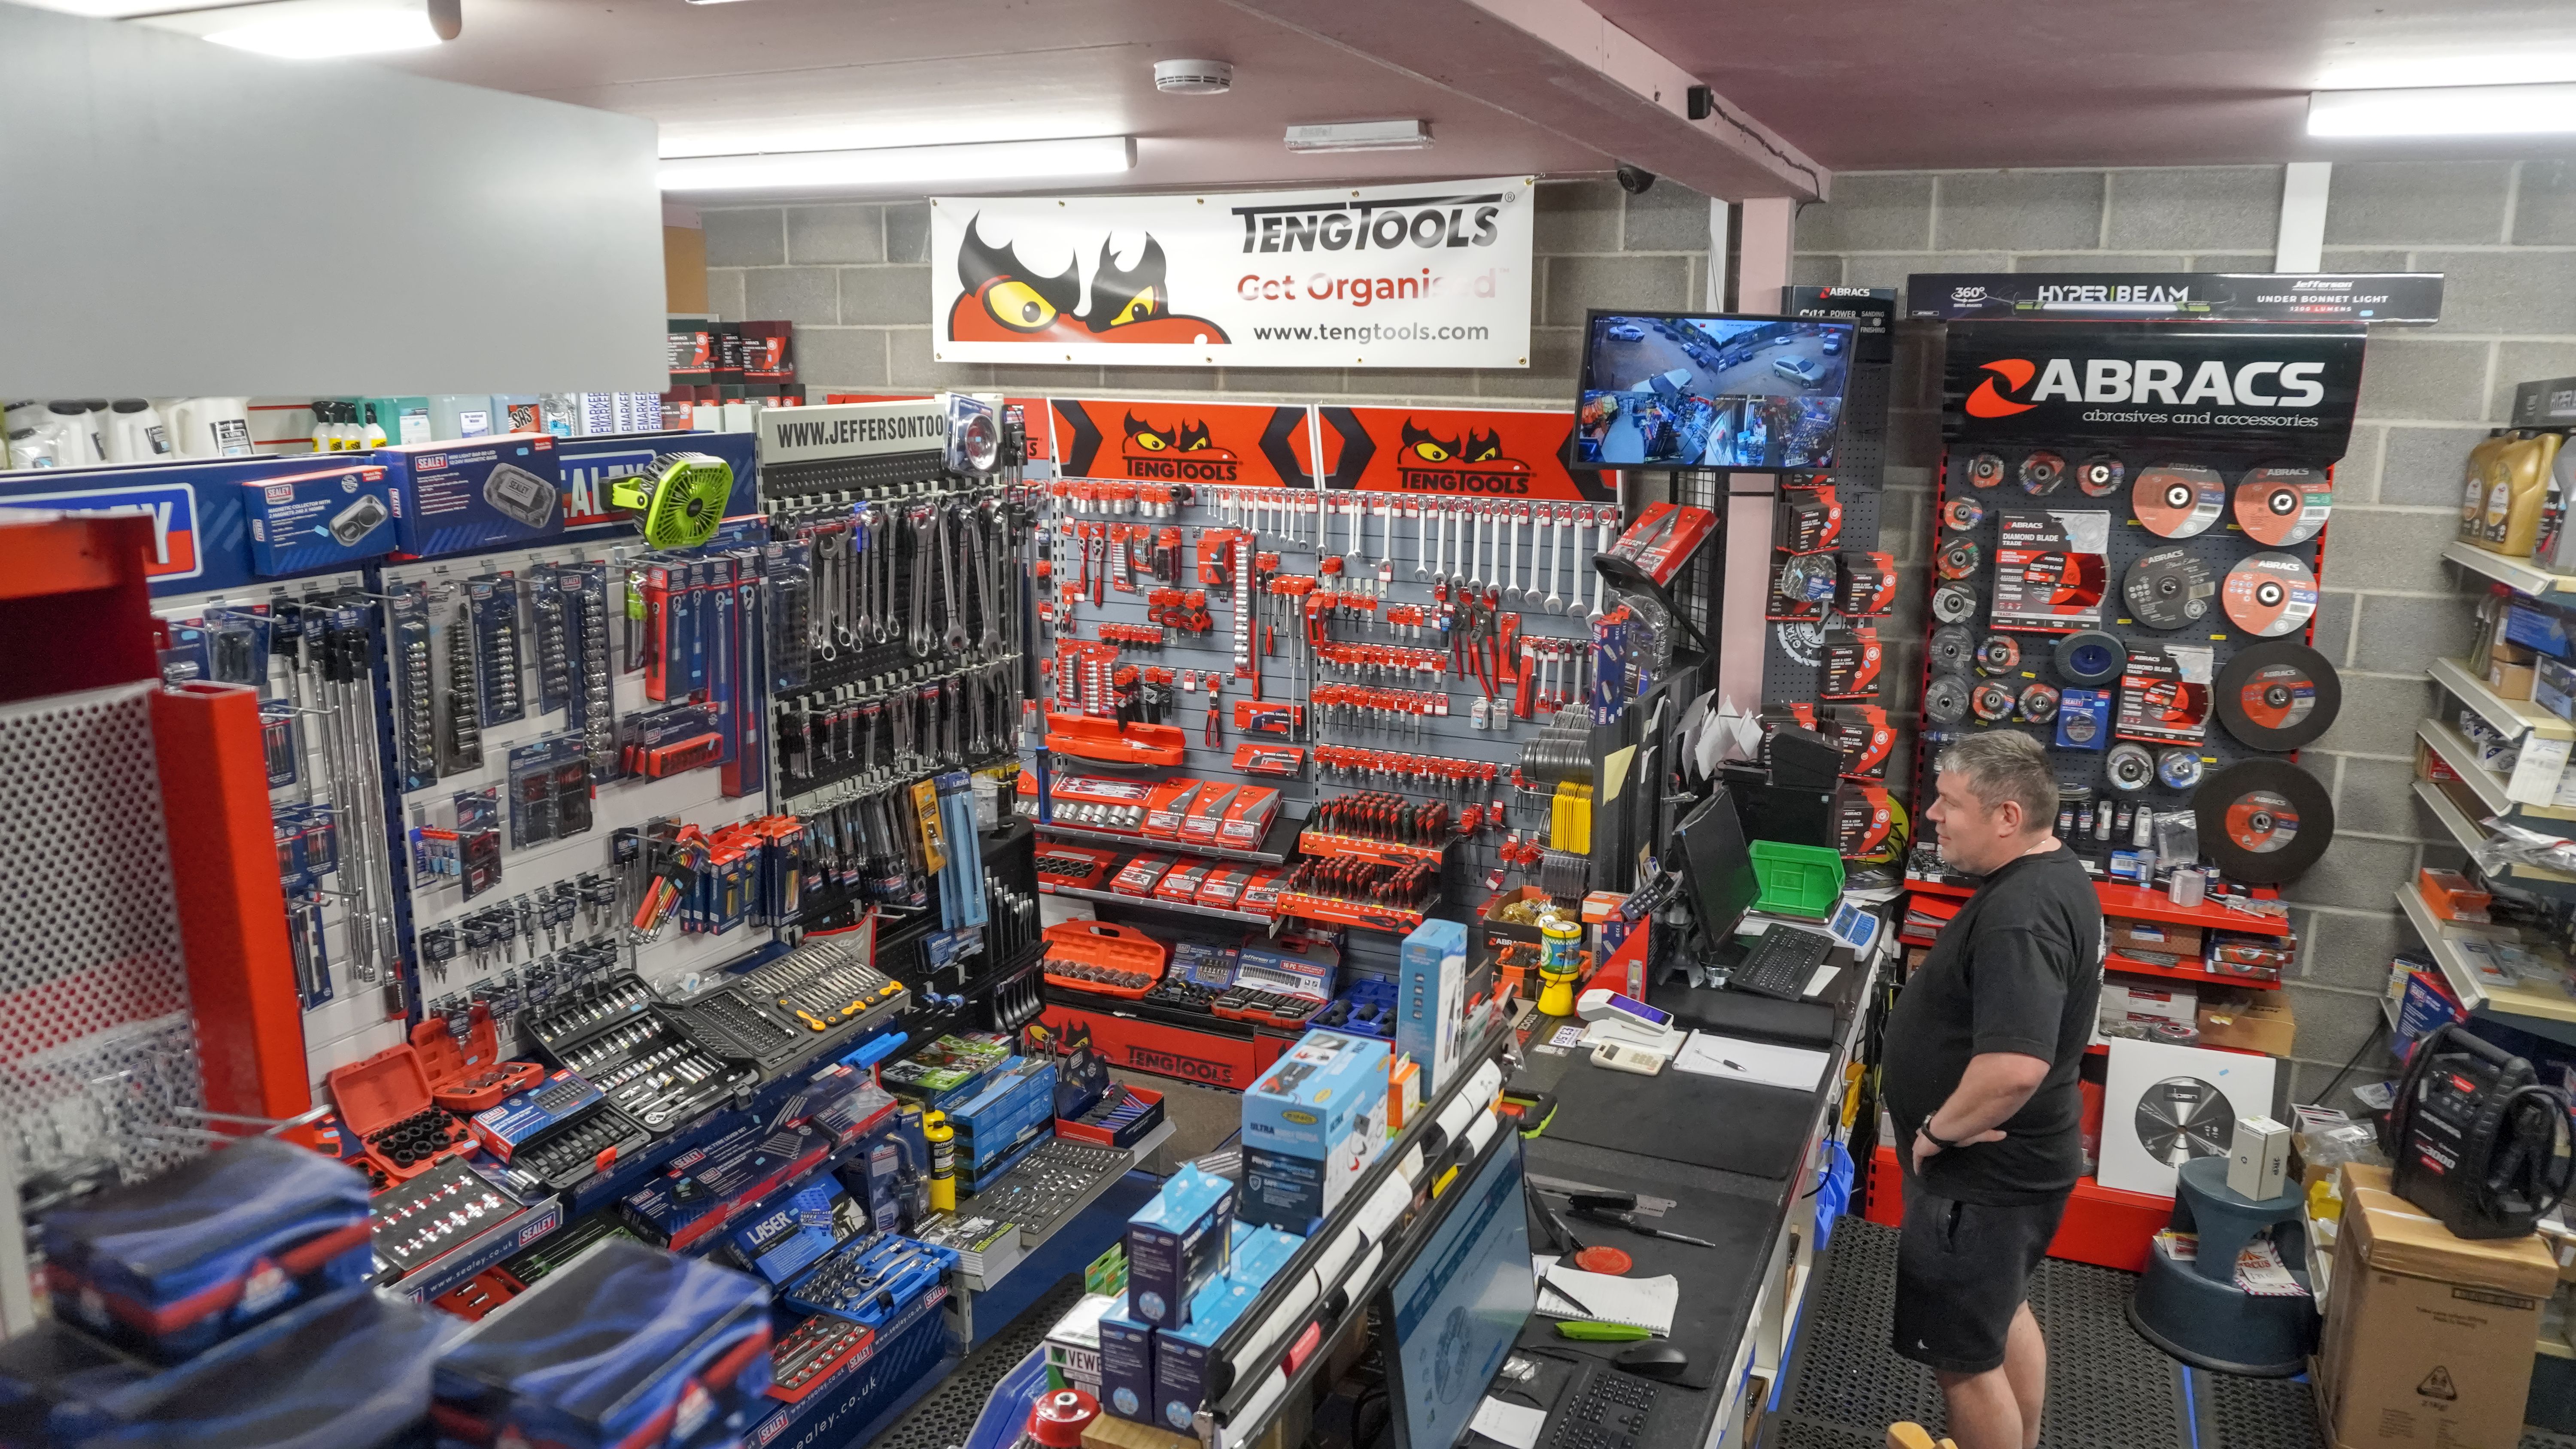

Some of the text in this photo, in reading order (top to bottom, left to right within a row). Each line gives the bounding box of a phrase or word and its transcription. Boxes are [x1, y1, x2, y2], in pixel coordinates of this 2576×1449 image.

[1232, 194, 1502, 253] TENGTOOLS
[1237, 267, 1496, 307] Get Organid
[1830, 288, 1870, 297] ABRACS
[2293, 280, 2354, 288] Jefferson
[2257, 295, 2388, 303] UNDER BONNET LIGHT
[1254, 321, 1489, 348] www.tengtools.com
[2031, 359, 2325, 407] ABRACS
[512, 406, 533, 429] SAS
[2083, 409, 2319, 427] abrasives and accessories
[417, 457, 446, 469] SEALEY
[1122, 456, 1237, 481] TENGTOOLS
[1397, 467, 1530, 494] TENGTOOLS
[268, 486, 290, 497] SEALEY
[292, 501, 316, 509] COLLECTOR
[2011, 521, 2043, 530] ABRACS
[2148, 549, 2184, 564] ABRACS
[2257, 560, 2300, 571] ABRACS
[2263, 669, 2296, 678] ABRACS
[952, 778, 969, 787] LASER
[2253, 796, 2287, 806] ABRACS
[1553, 1027, 1574, 1044] £3.50
[1126, 1045, 1233, 1084] TENGTOOLS
[482, 1108, 504, 1121] SEALEY
[713, 1140, 724, 1149] TYRE
[725, 1132, 738, 1142] LEVER
[673, 1150, 703, 1169] SEALEY
[747, 1212, 793, 1245] LASER
[914, 1213, 944, 1234] Jefferson
[430, 1216, 553, 1292] www.sealey.co.uk SEALEY
[875, 1286, 947, 1345] www.sealey.co.uk SEALEY
[790, 1347, 872, 1414] www.sealey.co.uk SEALEY
[793, 1376, 877, 1449] ealey.co.uk
[761, 1414, 784, 1440] SEALEY
